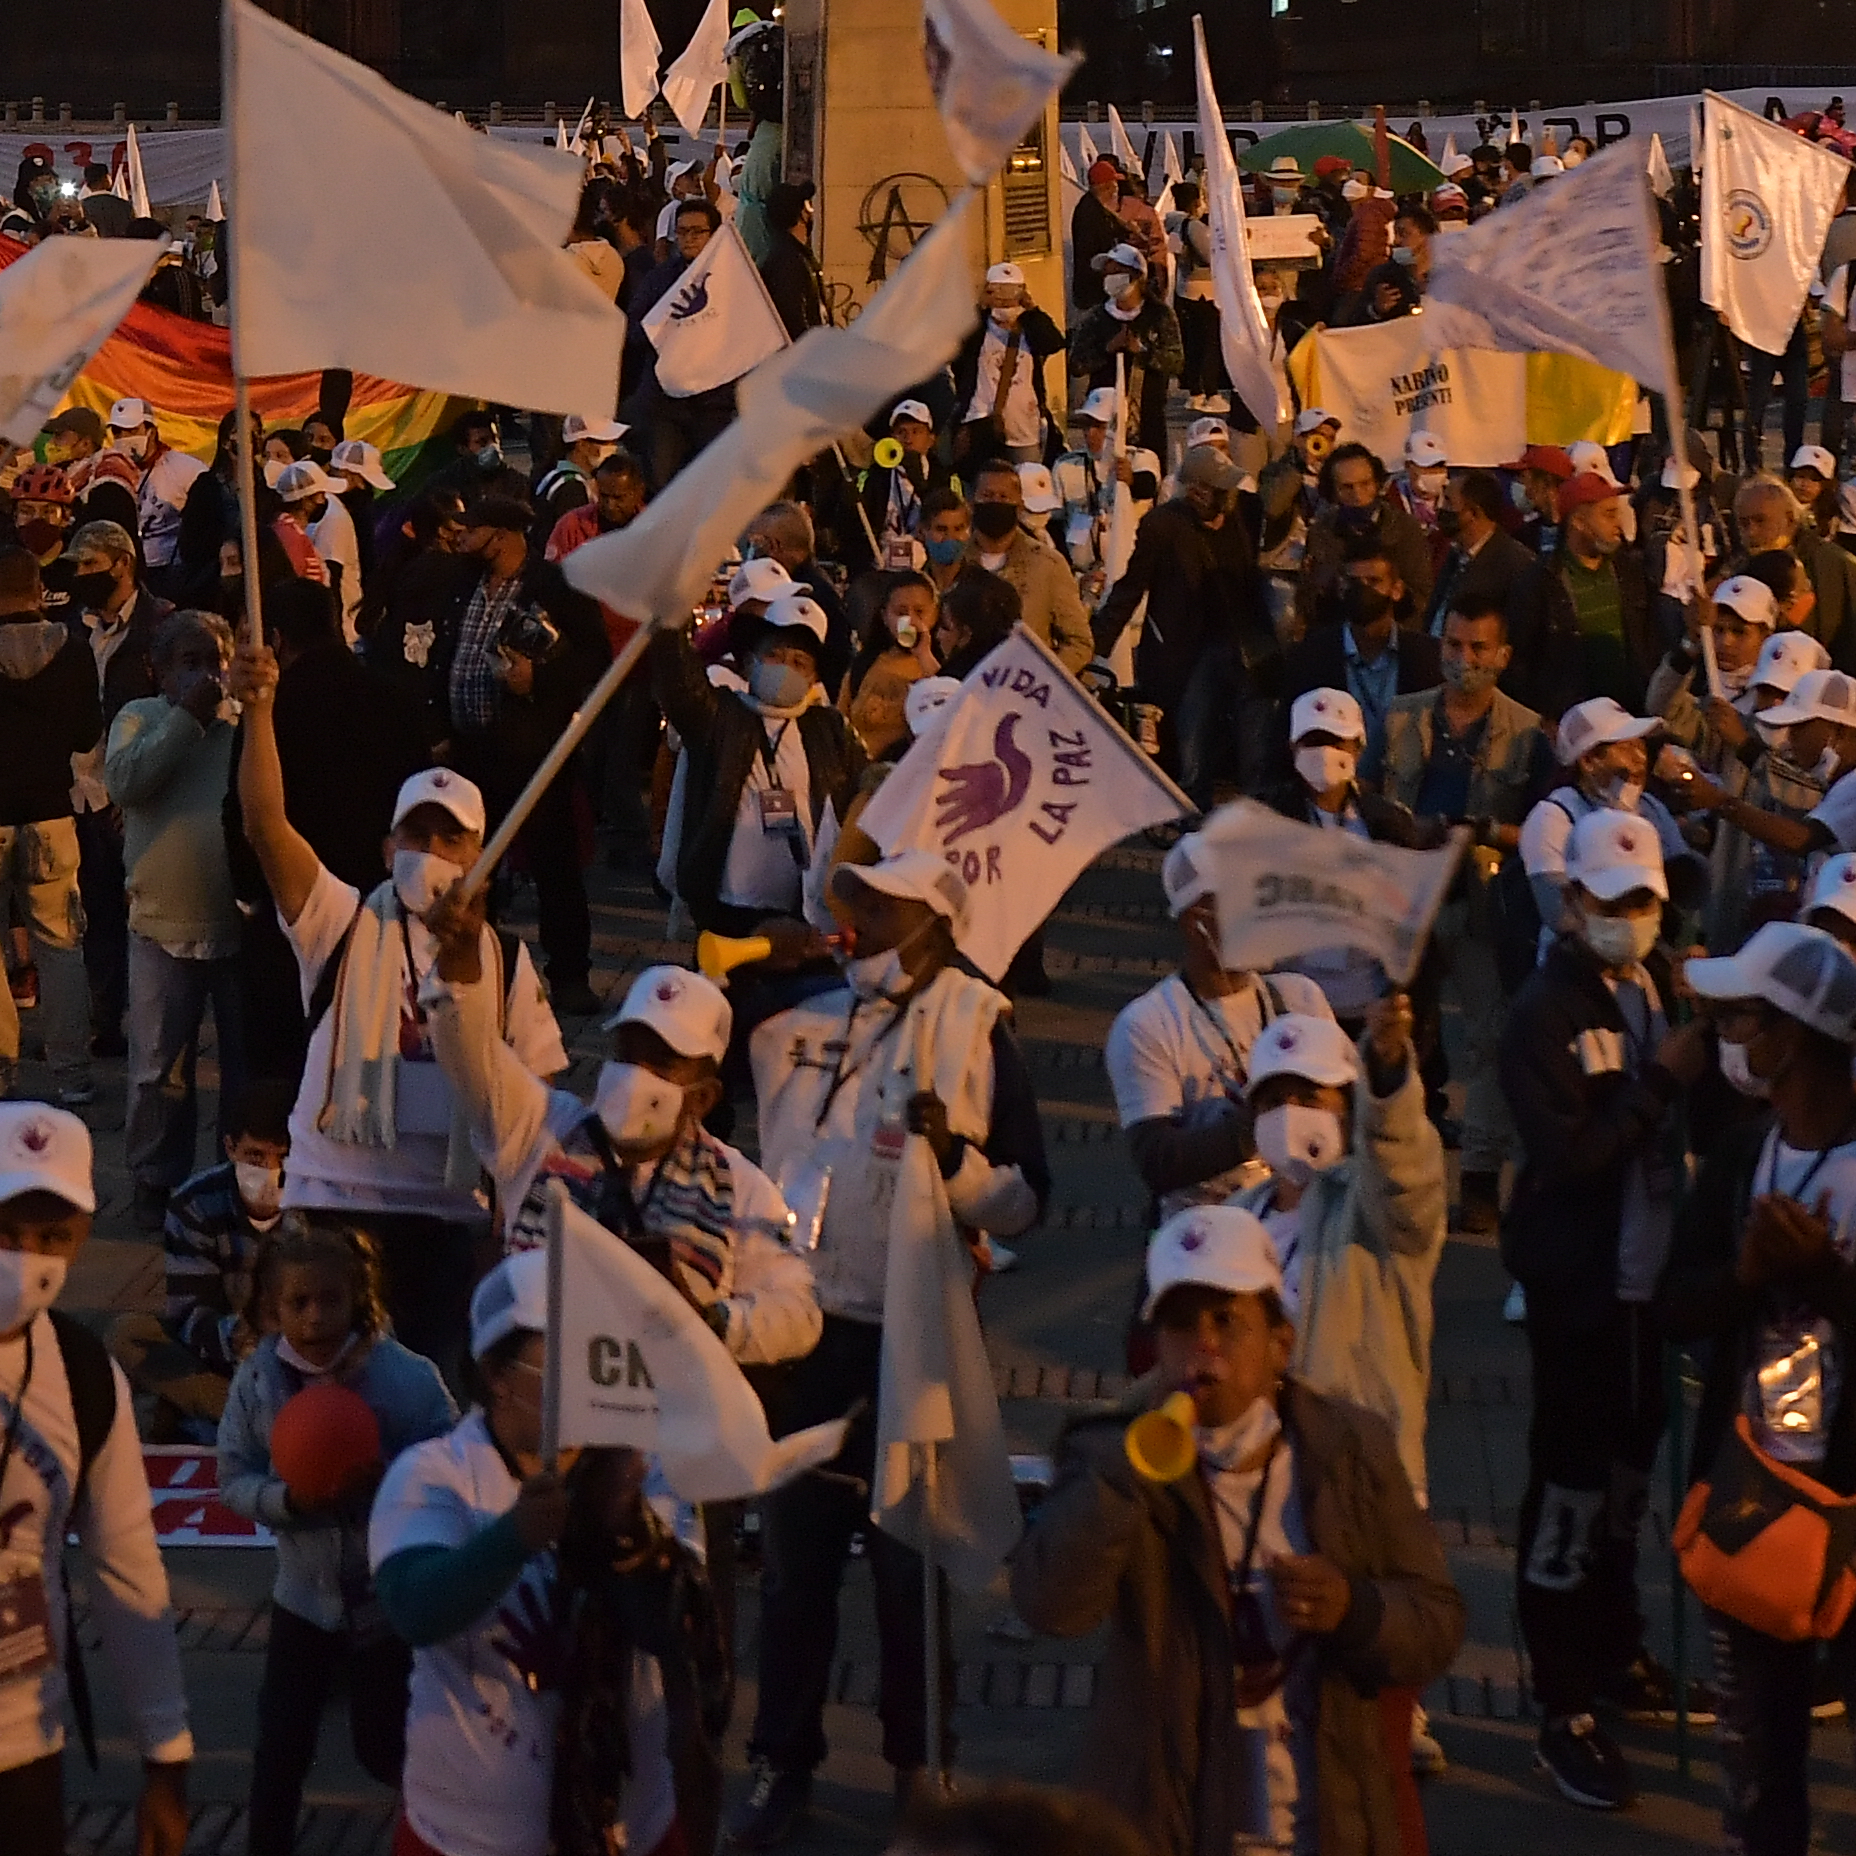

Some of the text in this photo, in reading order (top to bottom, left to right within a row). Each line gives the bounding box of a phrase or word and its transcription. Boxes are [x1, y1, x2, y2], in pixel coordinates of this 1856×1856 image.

[982, 667, 1051, 709] VIDA
[1028, 729, 1093, 845] LA PAZ
